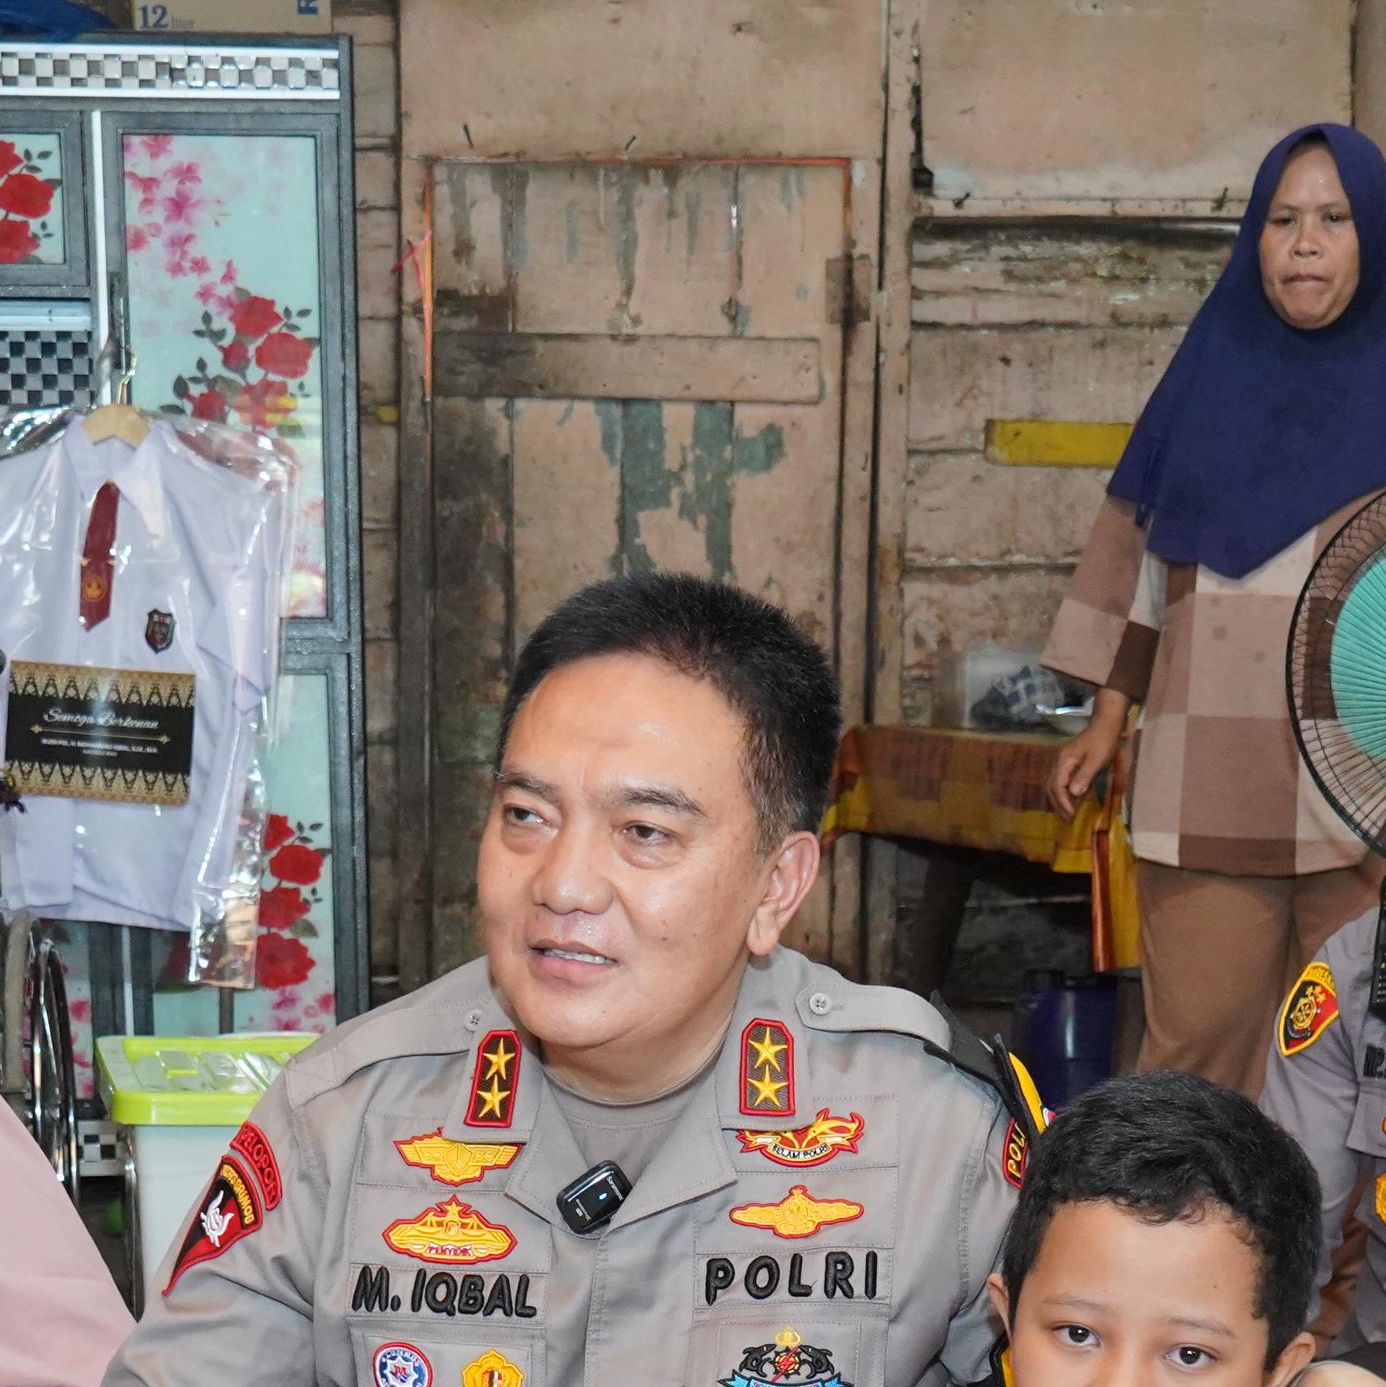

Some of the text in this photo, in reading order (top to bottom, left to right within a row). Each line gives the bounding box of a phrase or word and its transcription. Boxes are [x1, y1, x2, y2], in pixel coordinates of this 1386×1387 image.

[139, 4, 169, 29] 12
[43, 708, 95, 726] Semoga
[802, 1143, 831, 1159] POLRI
[705, 1250, 879, 1306] POLRI
[351, 1264, 537, 1319] M. IQBAL
